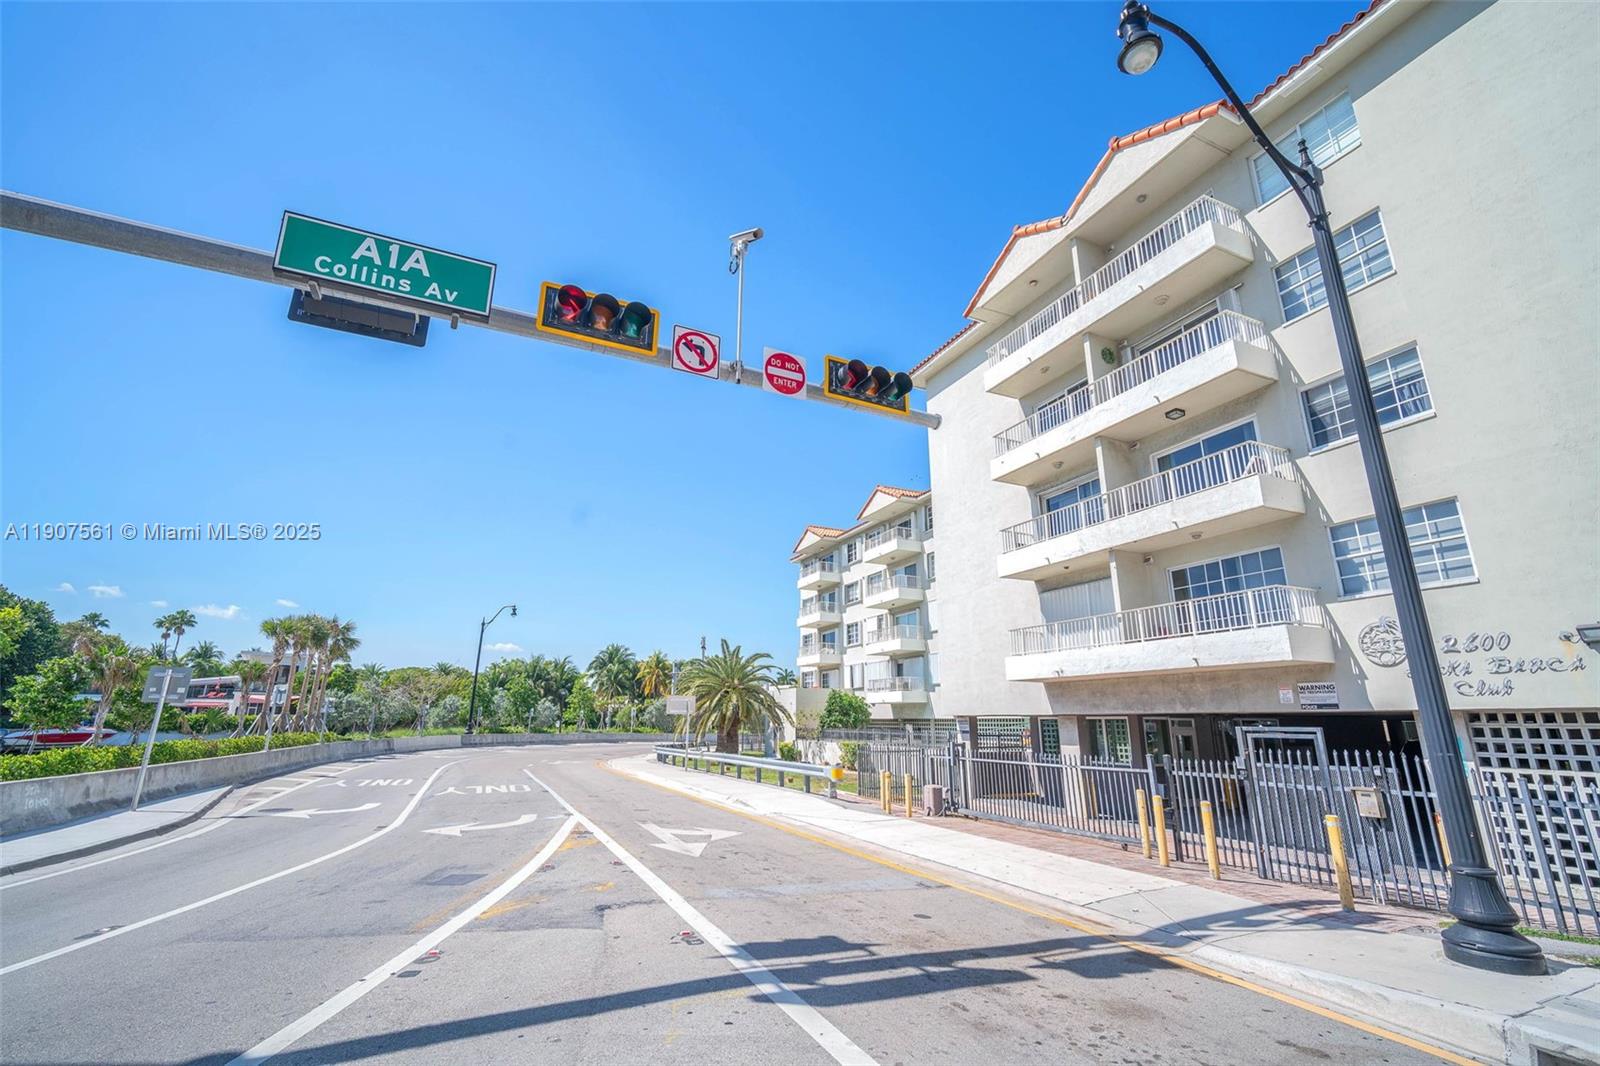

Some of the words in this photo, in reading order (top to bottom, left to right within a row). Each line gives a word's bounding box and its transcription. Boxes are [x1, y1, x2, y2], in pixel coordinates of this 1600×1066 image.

[351, 237, 430, 278] A1A
[314, 255, 411, 292] Collins
[424, 282, 459, 302] Av
[771, 358, 781, 367] DO
[785, 362, 800, 371] NOT
[773, 376, 797, 389] ENTER
[1440, 631, 1511, 654] 2600
[1454, 677, 1515, 697] Club
[317, 779, 414, 787] ONLY
[434, 784, 532, 795] ONLY
